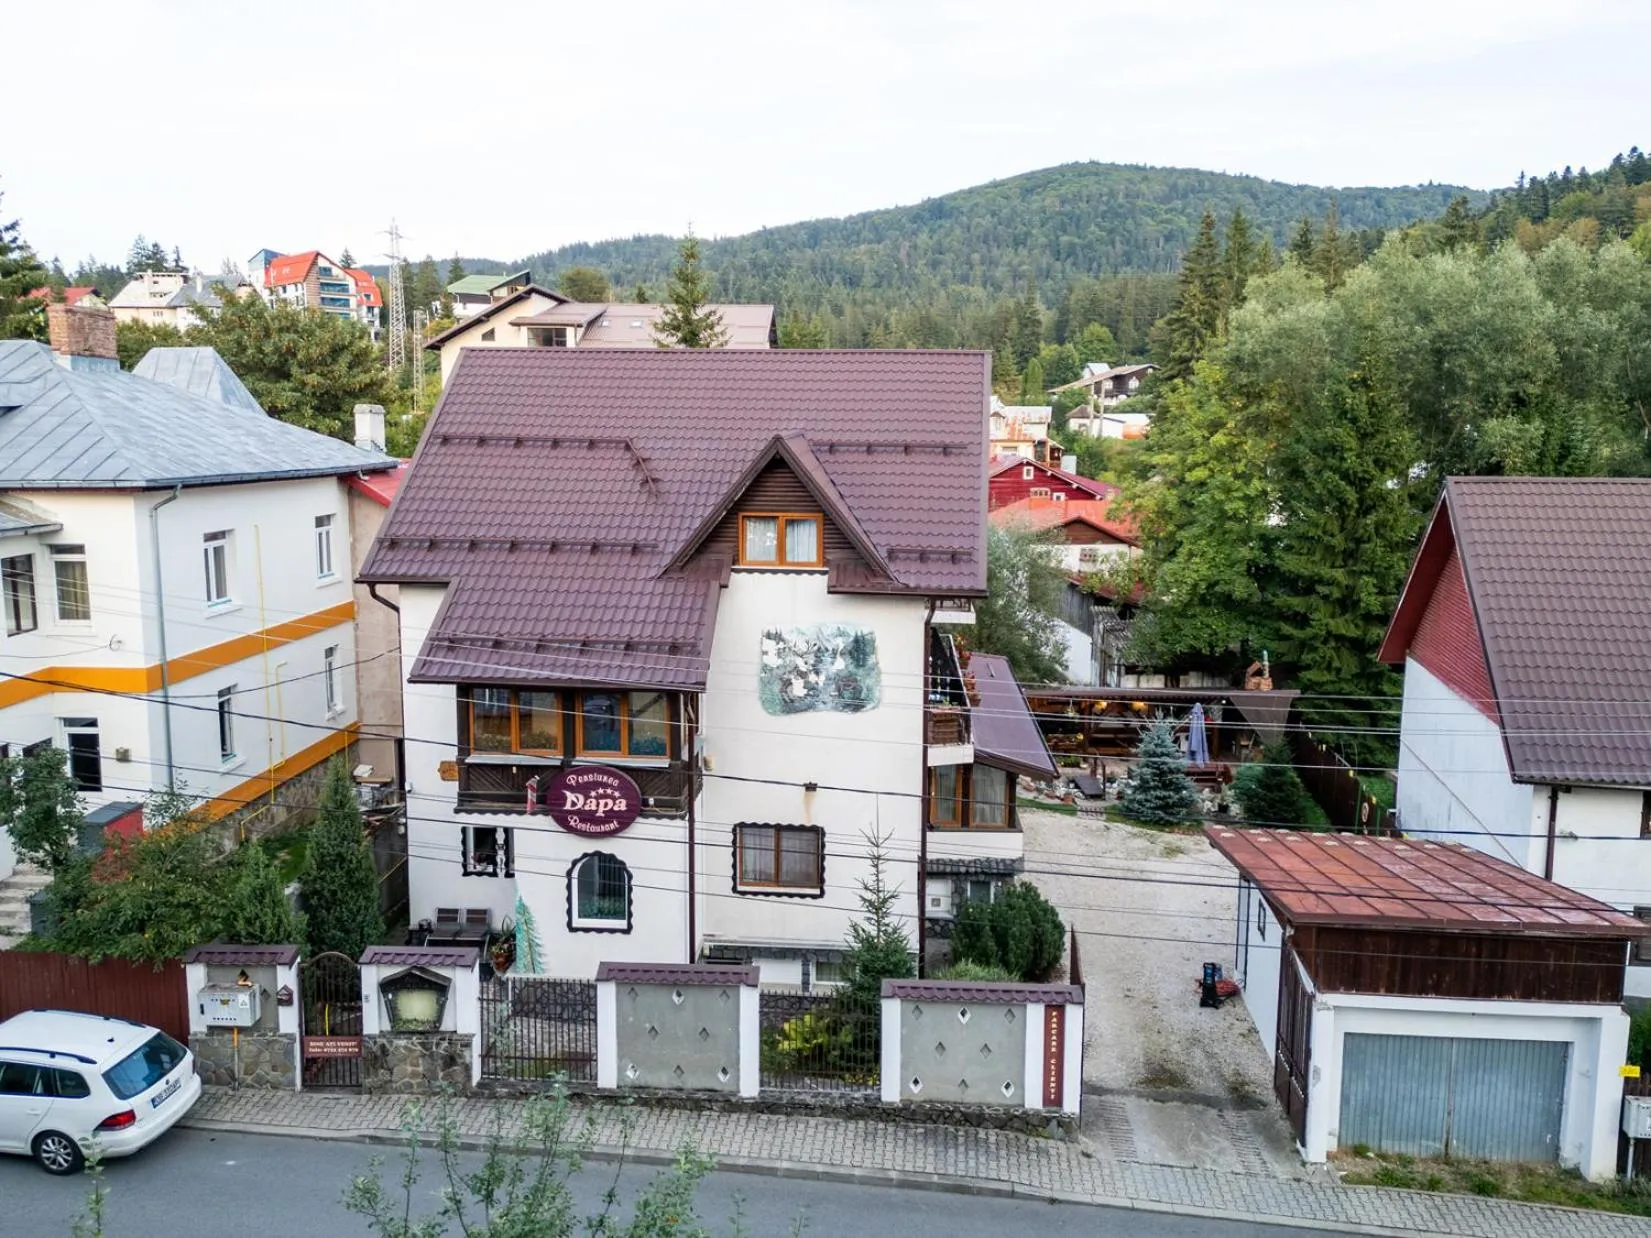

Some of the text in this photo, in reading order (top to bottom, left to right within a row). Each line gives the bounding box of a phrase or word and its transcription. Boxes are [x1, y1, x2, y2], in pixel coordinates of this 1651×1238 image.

[566, 772, 620, 787] Pensiunea
[562, 790, 627, 817] Dapa
[567, 814, 620, 833] Restaurant
